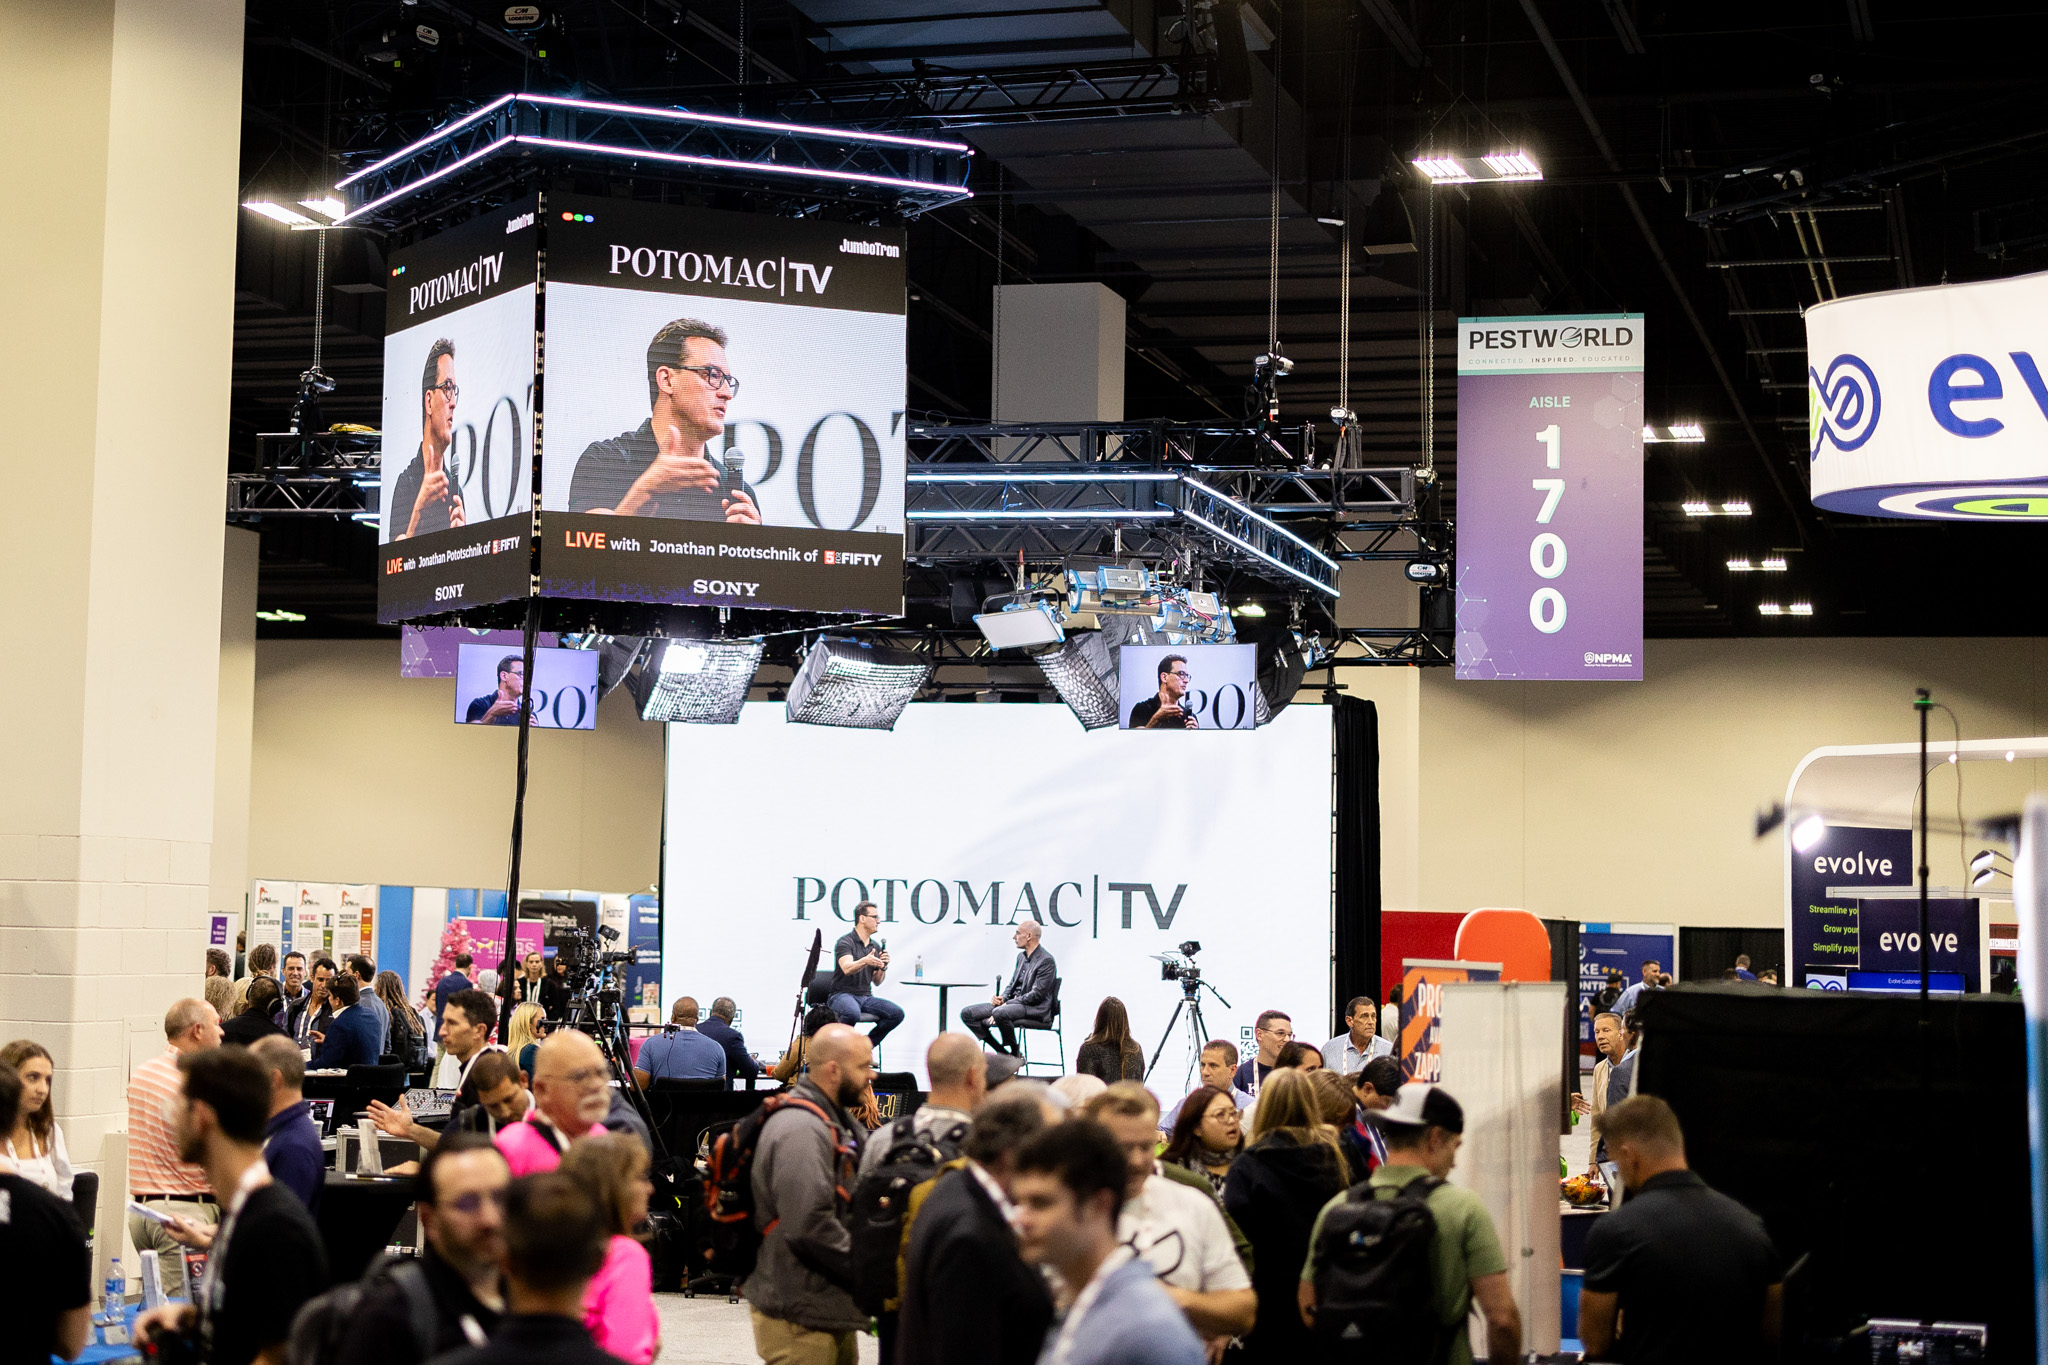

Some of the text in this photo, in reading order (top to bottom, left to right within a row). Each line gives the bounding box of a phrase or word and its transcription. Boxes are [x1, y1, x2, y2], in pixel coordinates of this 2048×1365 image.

[839, 238, 900, 258] JumboTron
[1469, 326, 1634, 350] PESTWORLD
[1468, 357, 1527, 365] CONNECTED.
[1529, 396, 1571, 408] AISLE
[565, 530, 606, 550] LIVE
[610, 537, 641, 552] with
[650, 539, 715, 557] Jonathan
[718, 544, 800, 562] Pototschnik
[803, 549, 818, 563] of
[386, 557, 403, 575] LIVE
[403, 559, 416, 571] with
[418, 552, 446, 569] Jonathan
[446, 543, 483, 562] Pototschnik
[483, 541, 492, 554] of
[435, 583, 464, 602] SONY
[693, 578, 759, 597] SONY
[1814, 851, 1893, 876] evolve
[1809, 904, 1848, 914] Streamline
[1823, 924, 1842, 933] Grow
[1813, 942, 1842, 953] Simplify
[1880, 932, 1958, 952] evove
